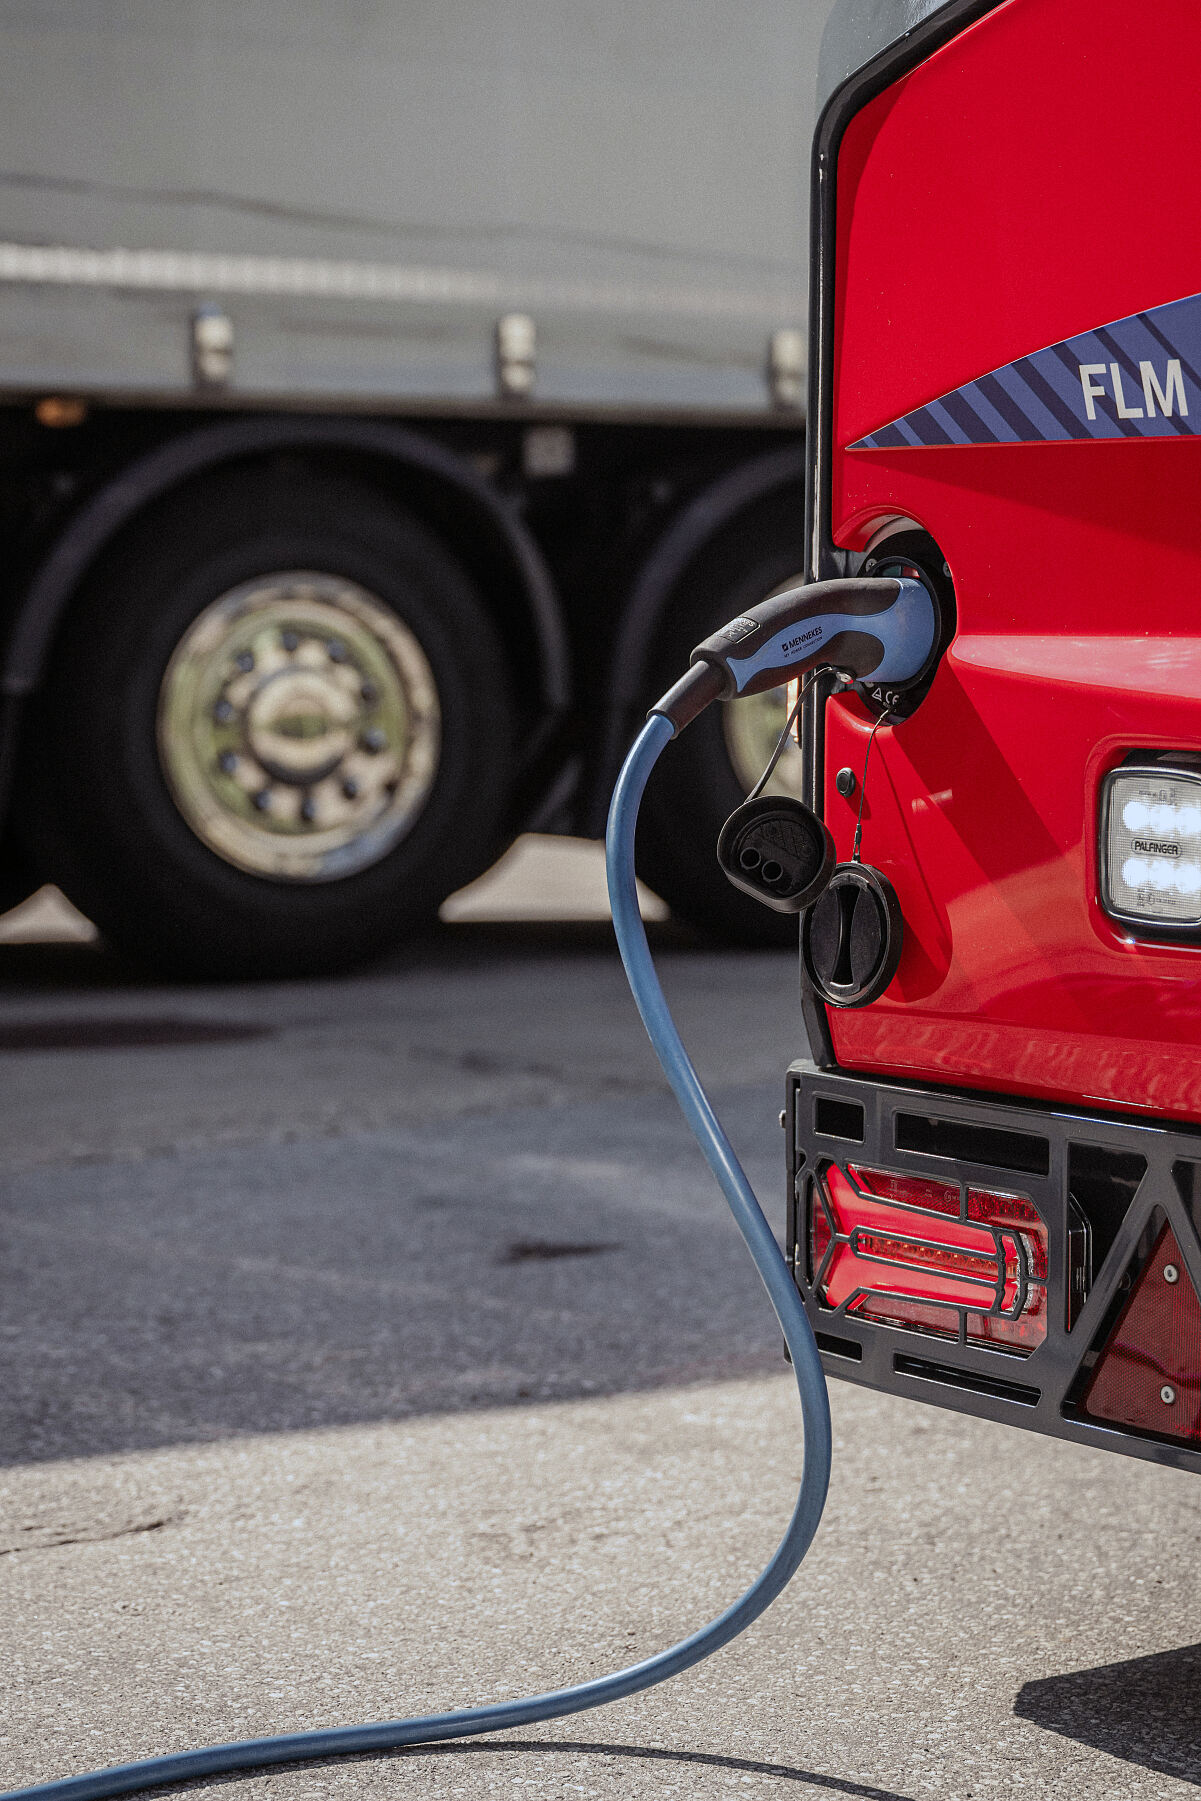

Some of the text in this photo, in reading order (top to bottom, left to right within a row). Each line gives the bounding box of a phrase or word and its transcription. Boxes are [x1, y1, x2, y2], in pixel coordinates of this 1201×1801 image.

[1079, 359, 1188, 420] FLM
[788, 626, 823, 648] MENNEKES
[1134, 841, 1178, 854] PALFINGER
